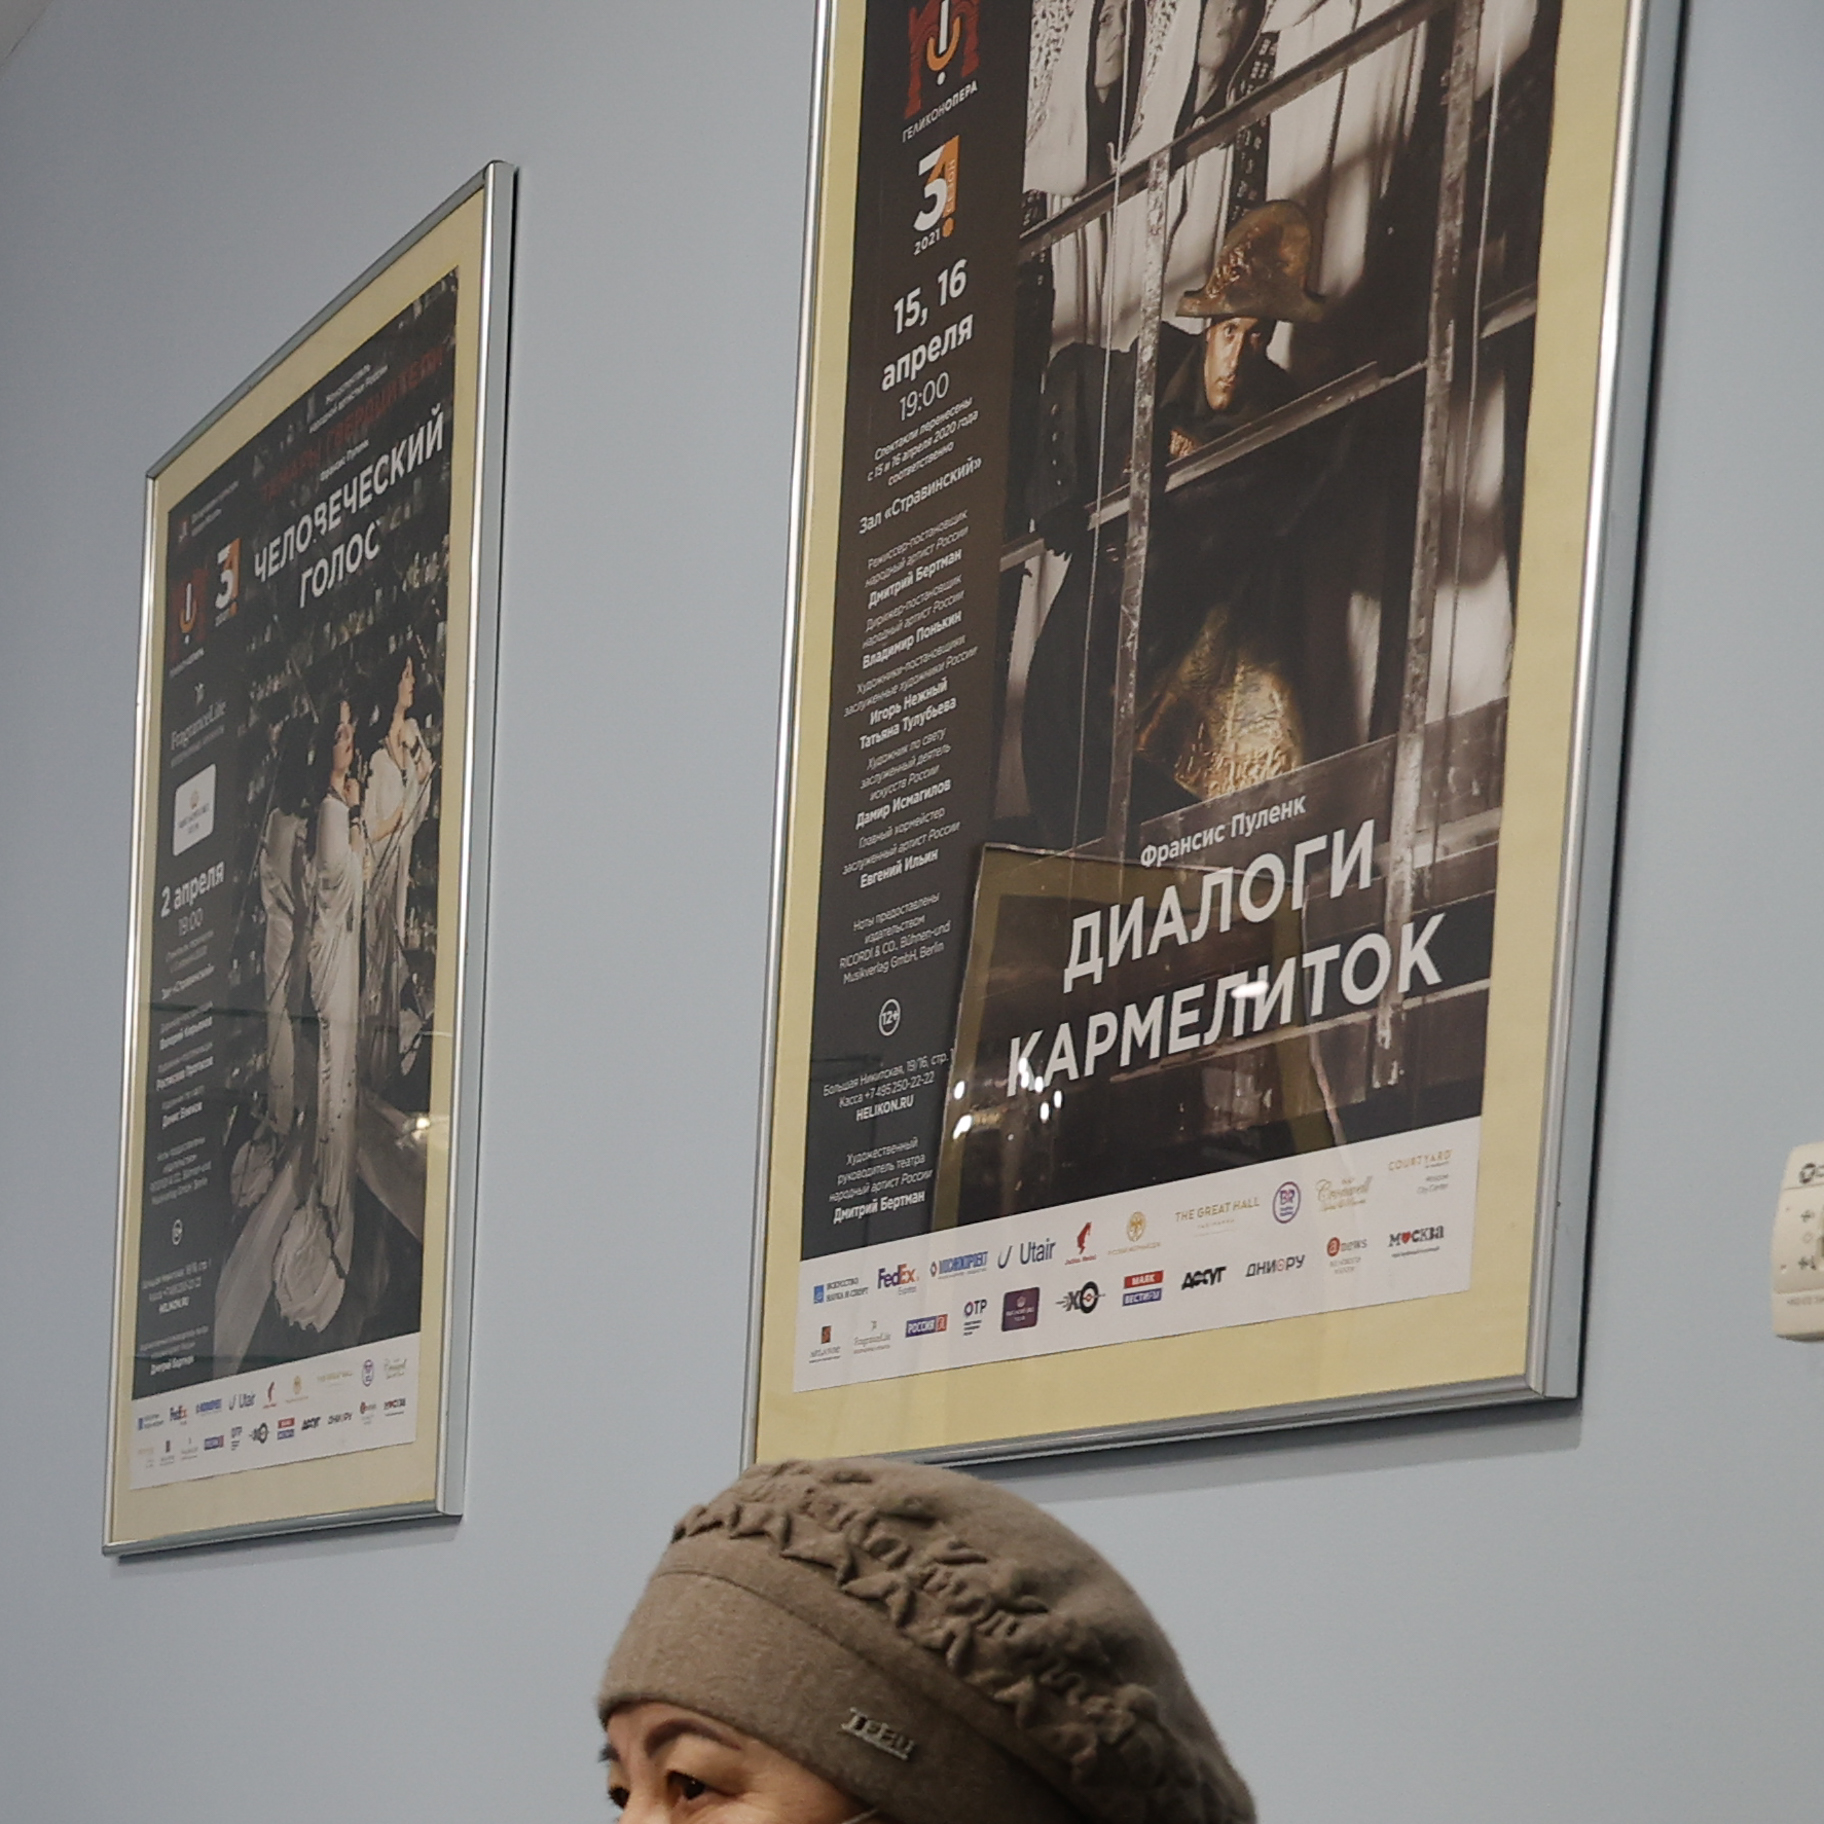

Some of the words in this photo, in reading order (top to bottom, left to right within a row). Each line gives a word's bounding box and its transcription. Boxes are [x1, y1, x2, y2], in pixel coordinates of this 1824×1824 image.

[913, 227, 941, 256] 2021
[894, 287, 928, 334] 15,
[937, 258, 968, 306] 16
[881, 313, 974, 391] апреля
[899, 372, 949, 422] 19:00
[874, 428, 919, 461] Спектакли
[919, 396, 973, 435] перенесены
[902, 436, 933, 462] апреля
[957, 410, 979, 430] года
[254, 402, 444, 583] ЧЕЛОВЕЧЕСКИЙ
[859, 511, 882, 535] Зал
[884, 456, 982, 520] «Стравинский»
[299, 519, 381, 608] ГОЛОС
[865, 556, 906, 588] народный
[906, 543, 935, 567] артист
[936, 526, 969, 550] России
[868, 570, 914, 610] Дмитрий
[915, 548, 962, 582] Бертман
[862, 619, 904, 650] народный
[904, 606, 933, 629] артист
[933, 589, 965, 614] России
[862, 634, 915, 670] Владимир
[916, 610, 962, 643] Понькин
[946, 646, 979, 670] России
[870, 702, 902, 725] Игорь
[903, 676, 948, 710] Нежный
[859, 723, 900, 750] Татьяна
[902, 697, 957, 732] Тулубьева
[909, 738, 922, 752] по
[922, 728, 947, 748] свету
[917, 743, 952, 766] деятель
[855, 804, 891, 831] Дамир
[892, 778, 952, 813] Исмагилов
[869, 777, 908, 801] искусств
[908, 764, 940, 786] России
[858, 825, 894, 849] Главный
[898, 834, 928, 854] артист
[928, 821, 961, 842] России
[1139, 822, 1227, 869] Франсис
[1230, 794, 1307, 840] Пуленк
[161, 885, 171, 918] 2
[174, 861, 225, 910] апреля
[860, 861, 902, 889] Евгений
[904, 848, 939, 872] Ильин
[853, 916, 875, 931] Ноты
[875, 892, 941, 925] предоставлены
[1062, 818, 1376, 995] ДИАЛОГИ
[839, 951, 875, 969] RICORDI
[843, 960, 890, 985] Musikverlag
[919, 941, 945, 960] Berlin
[1006, 911, 1447, 1098] КАРМЕЛИТОК
[823, 1077, 859, 1097] Большая
[931, 1052, 949, 1067] стр.
[839, 1094, 864, 1109] Касса
[856, 1094, 915, 1122] HELIKON.RU
[837, 1161, 896, 1187] руководитель
[896, 1152, 926, 1170] театра
[1388, 1149, 1452, 1172] COURTYARD
[828, 1181, 871, 1202] народный
[871, 1176, 900, 1195] артист
[900, 1169, 934, 1186] России
[833, 1197, 878, 1225] Дмитрий
[880, 1190, 926, 1212] Бертман
[1175, 1210, 1195, 1223] THE
[1196, 1202, 1231, 1218] GREAT
[1232, 1197, 1261, 1211] HALL
[1020, 1238, 1057, 1265] Utair
[878, 1263, 917, 1290] FedEx
[1131, 1273, 1156, 1286] МАЯК
